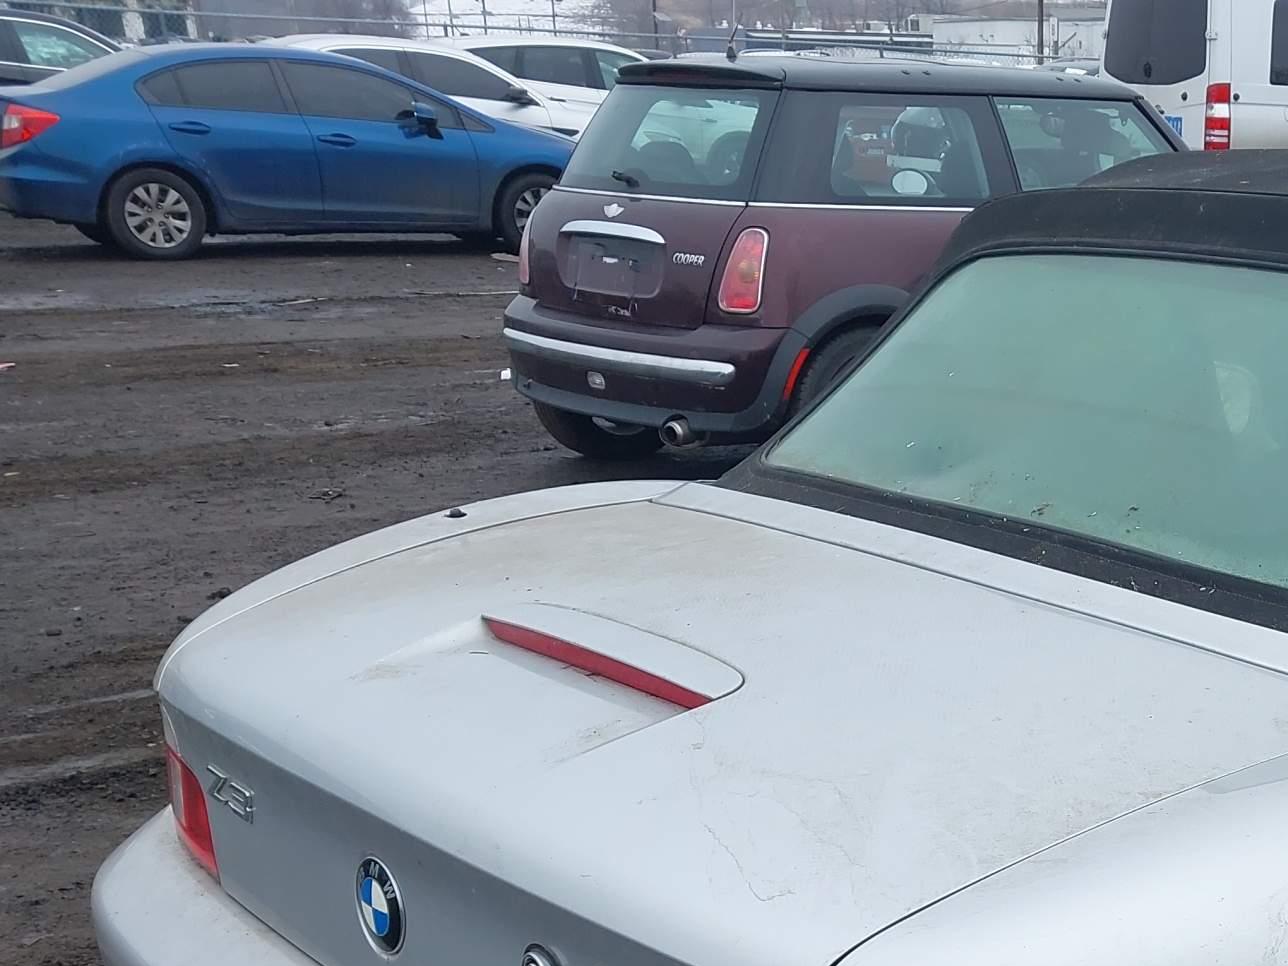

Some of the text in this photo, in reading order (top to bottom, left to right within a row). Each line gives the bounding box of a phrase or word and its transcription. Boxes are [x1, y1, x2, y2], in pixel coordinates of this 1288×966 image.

[672, 252, 705, 267] COOPER
[207, 765, 255, 824] Z3
[359, 861, 395, 899] BMW
